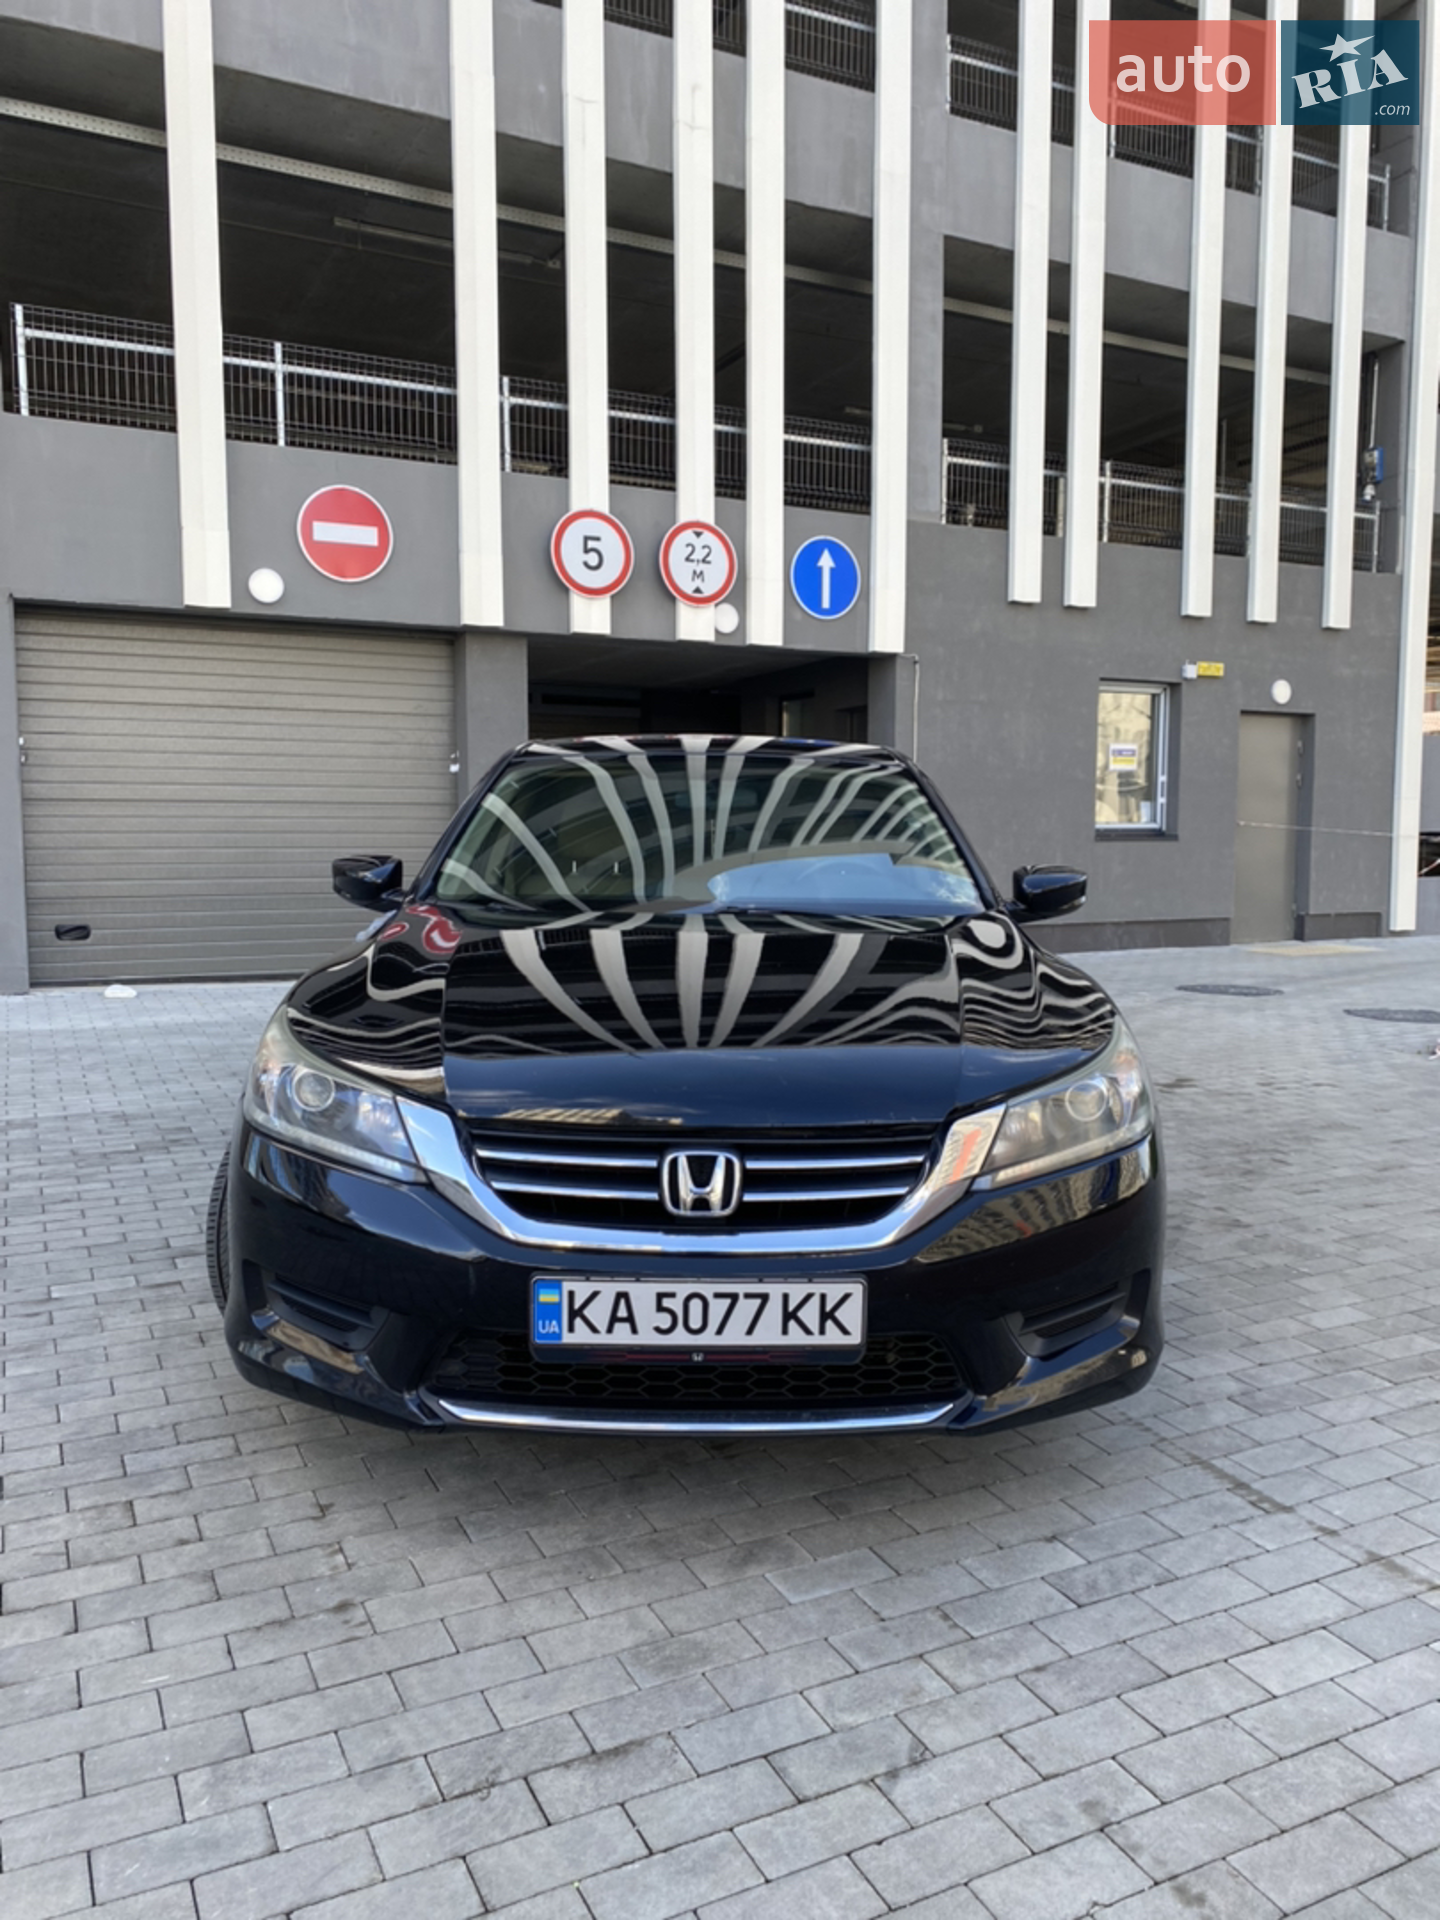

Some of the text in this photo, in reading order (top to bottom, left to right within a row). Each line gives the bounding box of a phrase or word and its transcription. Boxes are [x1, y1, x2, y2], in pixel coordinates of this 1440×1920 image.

[582, 535, 604, 571] 5
[684, 543, 713, 566] 2,2
[538, 1320, 560, 1334] UA
[567, 1290, 854, 1336] KA 5077 KK
